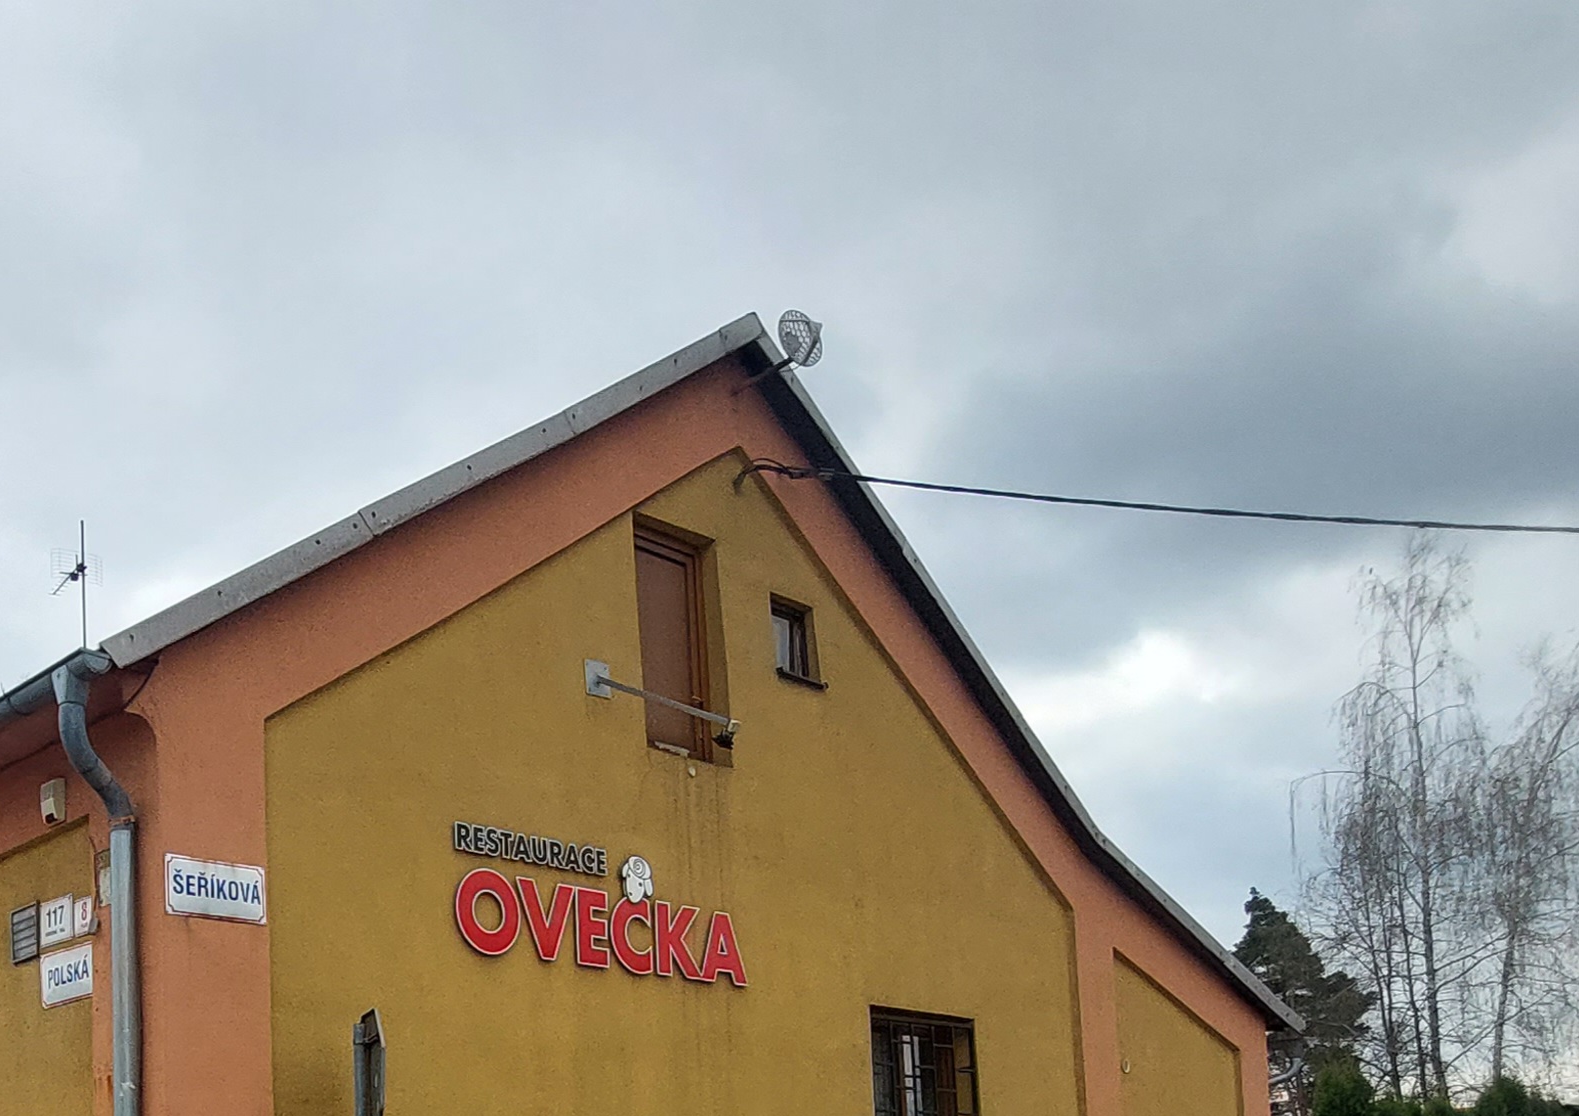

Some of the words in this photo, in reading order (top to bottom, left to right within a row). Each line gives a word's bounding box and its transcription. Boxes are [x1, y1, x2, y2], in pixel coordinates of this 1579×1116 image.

[454, 821, 608, 876] RESTAURACE
[172, 868, 261, 905] ŠEŘÍKOVÁ
[45, 904, 65, 928] 117
[47, 954, 90, 990] POLSKÁ
